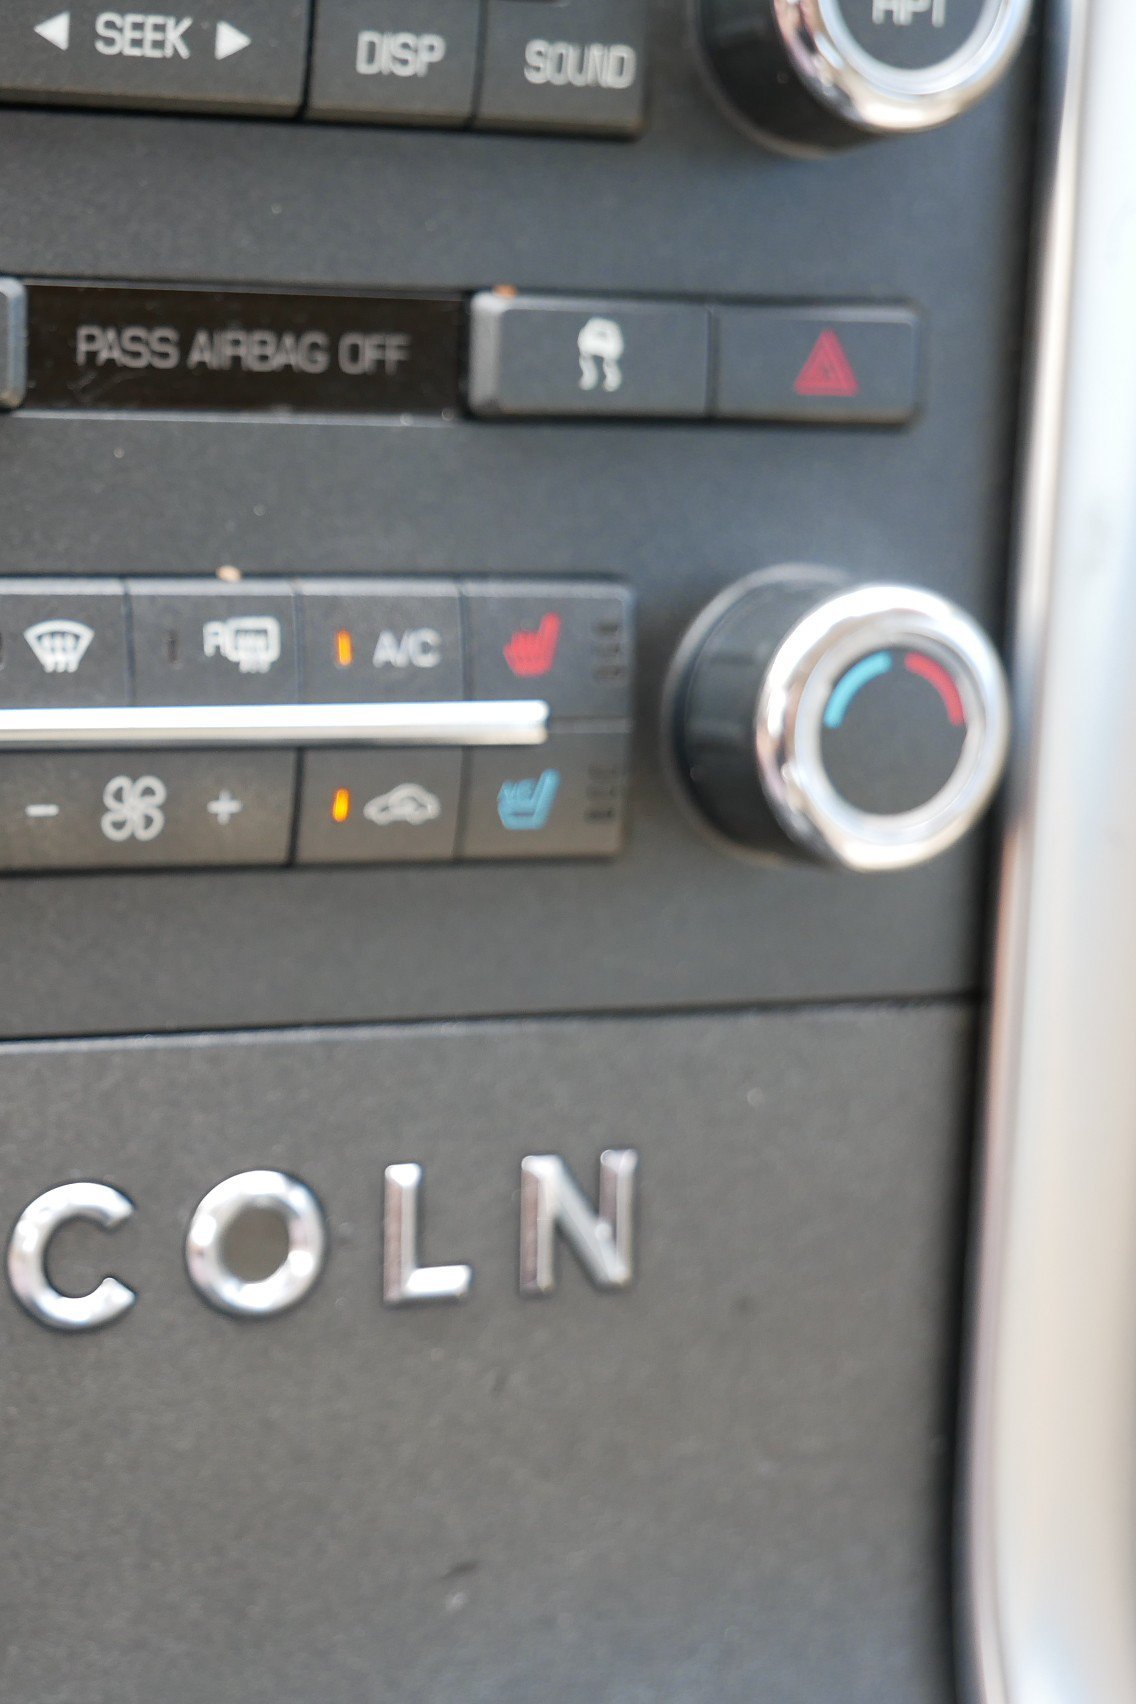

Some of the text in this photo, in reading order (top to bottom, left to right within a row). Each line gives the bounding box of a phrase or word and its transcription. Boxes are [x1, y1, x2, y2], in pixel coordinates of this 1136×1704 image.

[96, 12, 192, 59] SEEK
[356, 31, 445, 76] DISP
[524, 40, 634, 88] SOUND
[76, 325, 410, 375] PASS AIRBAG OFF
[372, 627, 441, 668] A/C
